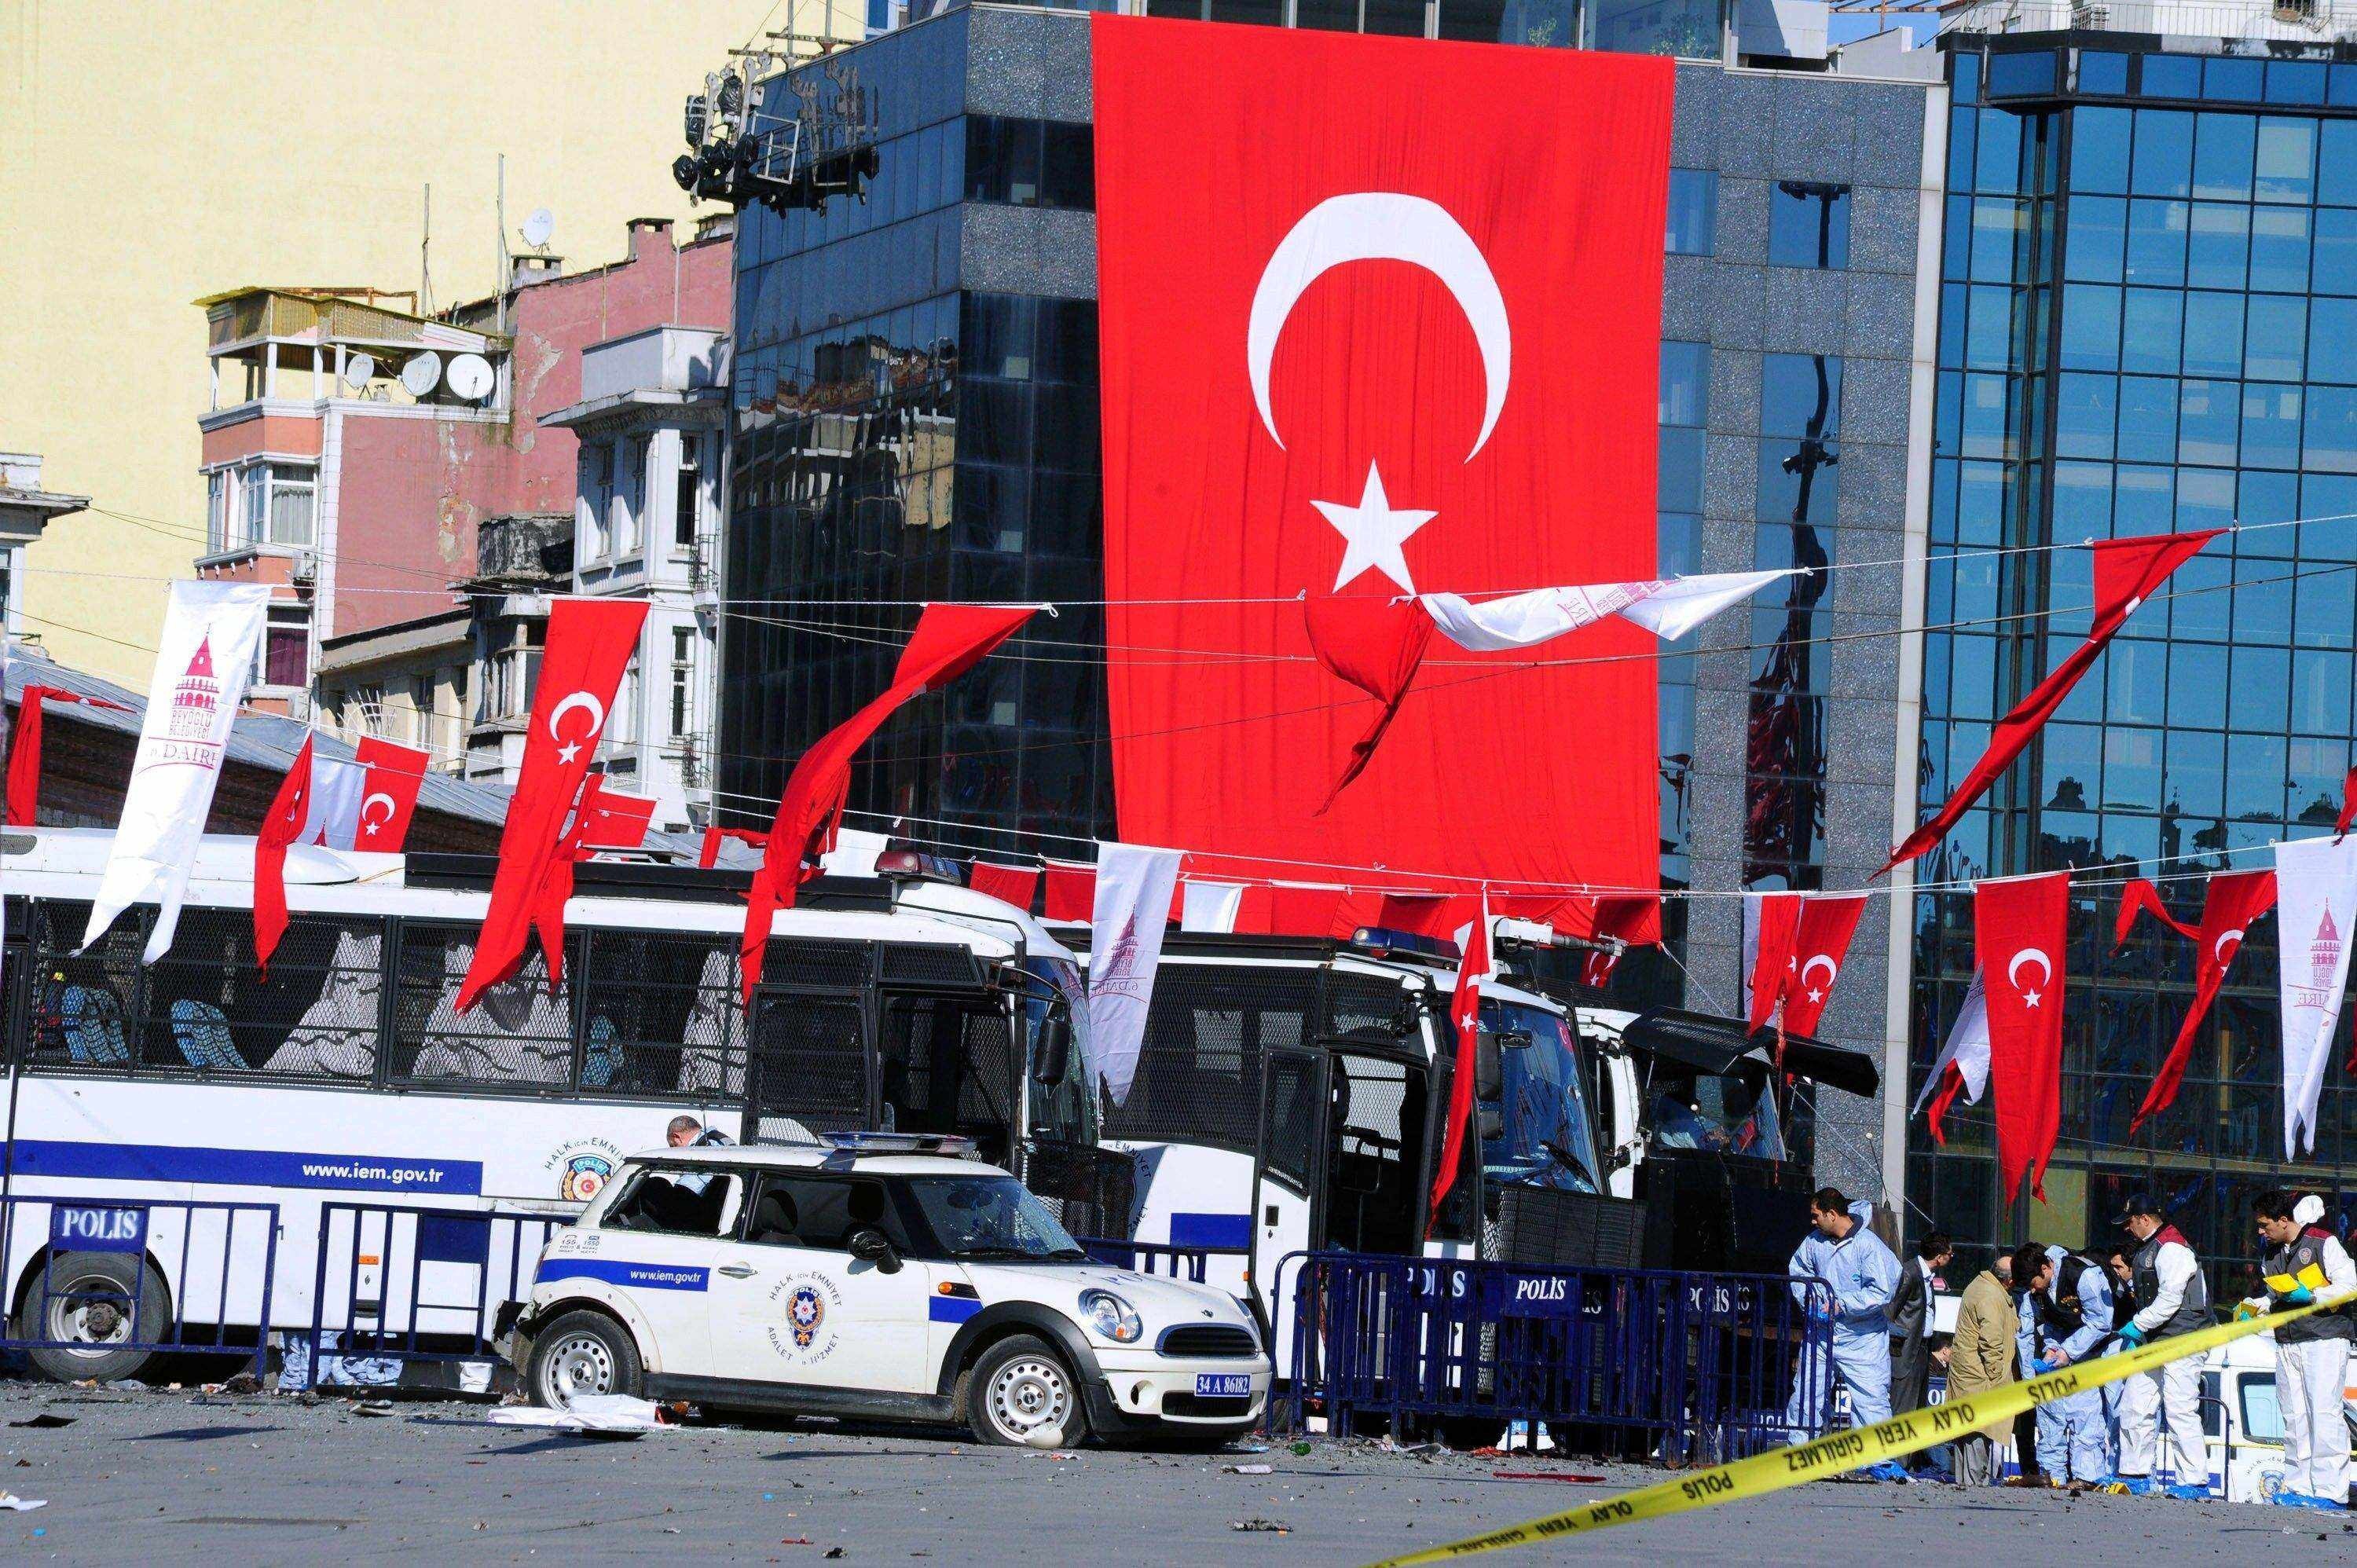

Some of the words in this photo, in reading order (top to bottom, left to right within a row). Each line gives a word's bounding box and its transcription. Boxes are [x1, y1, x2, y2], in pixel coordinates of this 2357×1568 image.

[544, 1141, 572, 1170] HALK
[302, 1162, 444, 1184] www.iem.gov.tr
[630, 1270, 702, 1284] www.iem.gov.tr
[769, 1274, 794, 1301] HALK
[1516, 1276, 1567, 1301] POLİS
[768, 1326, 794, 1361] ADALET
[1197, 1376, 1211, 1393] 34
[1212, 1376, 1222, 1393] A
[1223, 1376, 1248, 1393] 86182
[1932, 1404, 1975, 1433] OLAY
